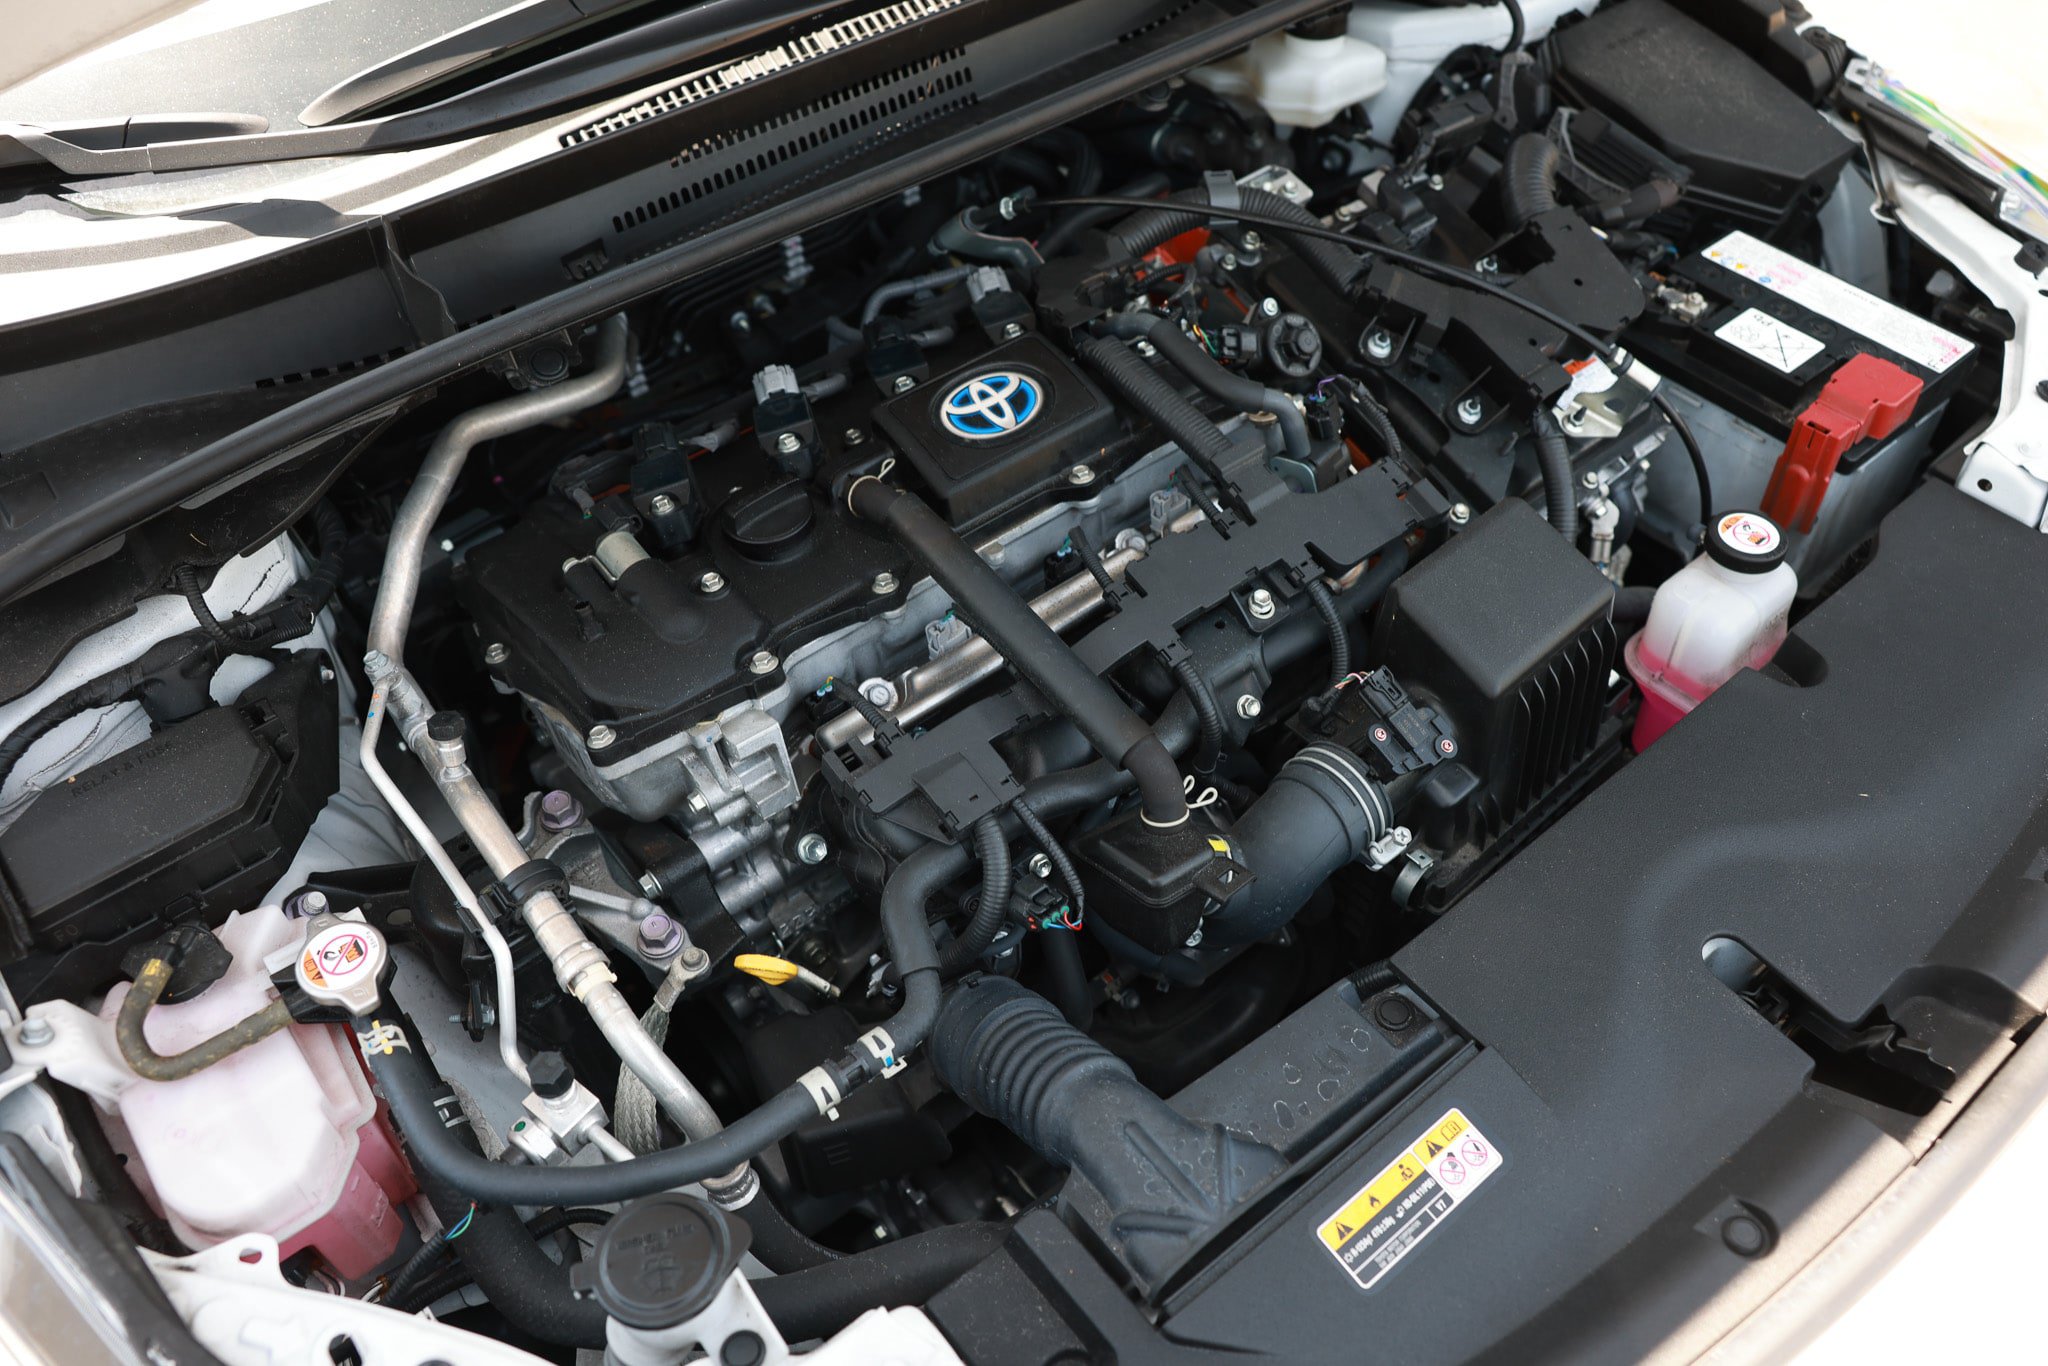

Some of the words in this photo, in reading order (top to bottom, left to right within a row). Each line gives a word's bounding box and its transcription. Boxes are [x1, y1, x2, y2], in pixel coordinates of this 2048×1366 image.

[71, 767, 118, 798] RELAY
[139, 741, 172, 764] FUSE
[1434, 1199, 1447, 1212] V7
